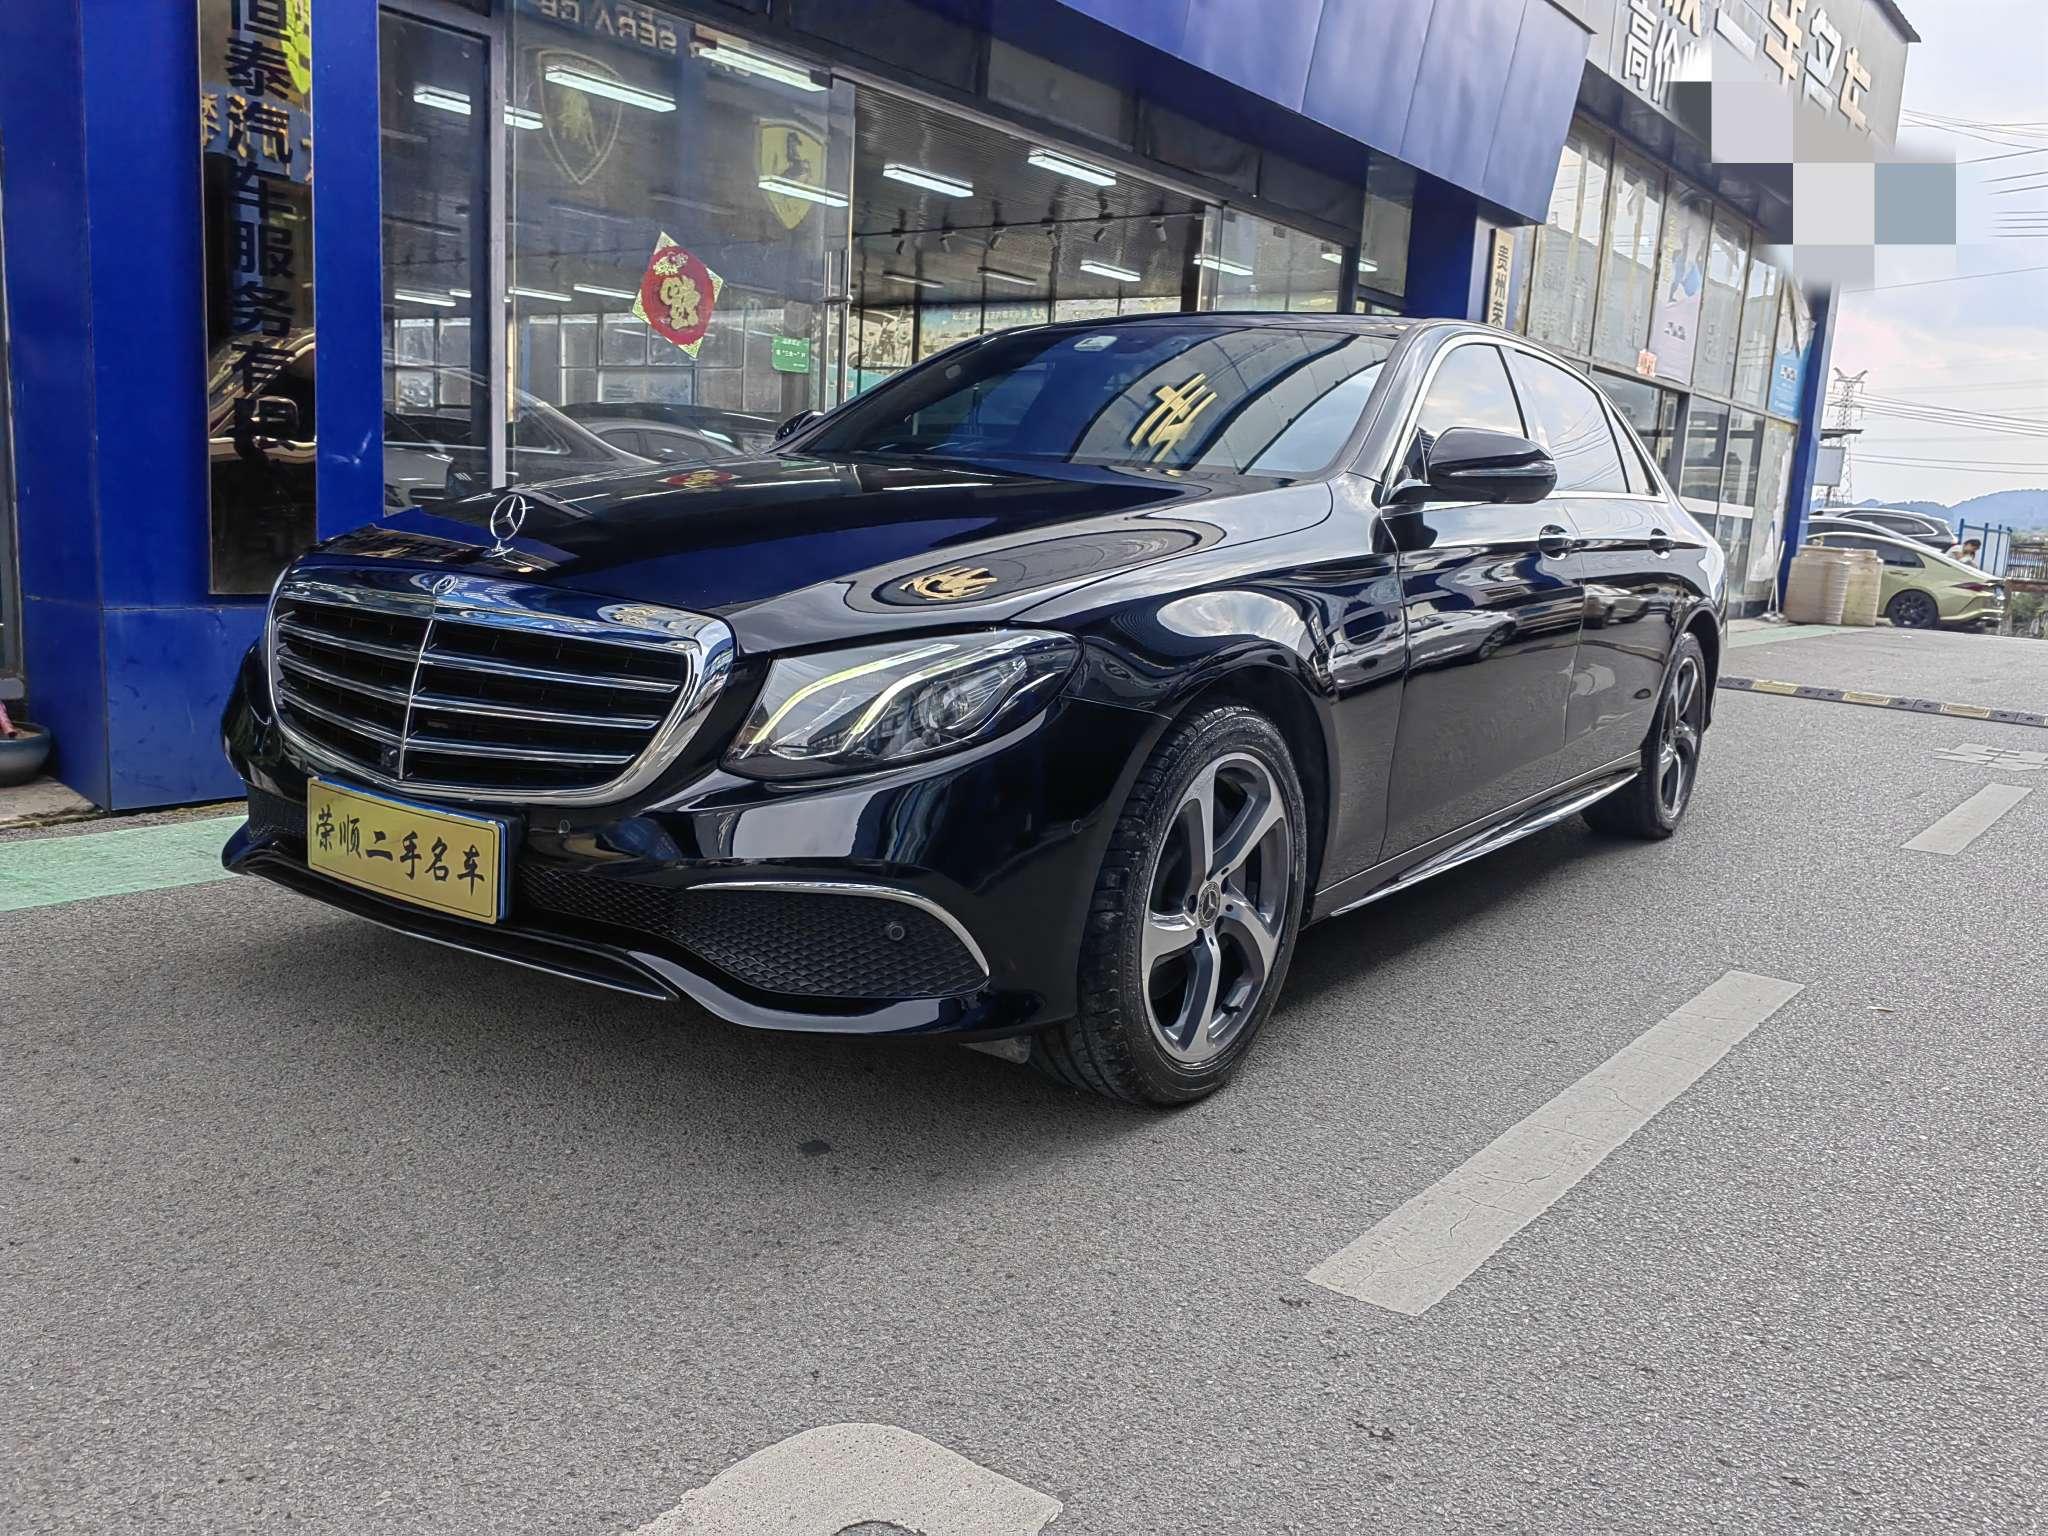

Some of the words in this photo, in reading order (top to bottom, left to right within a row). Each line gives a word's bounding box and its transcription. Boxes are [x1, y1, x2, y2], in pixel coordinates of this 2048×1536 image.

[316, 804, 485, 896] 荣顺二手名车
